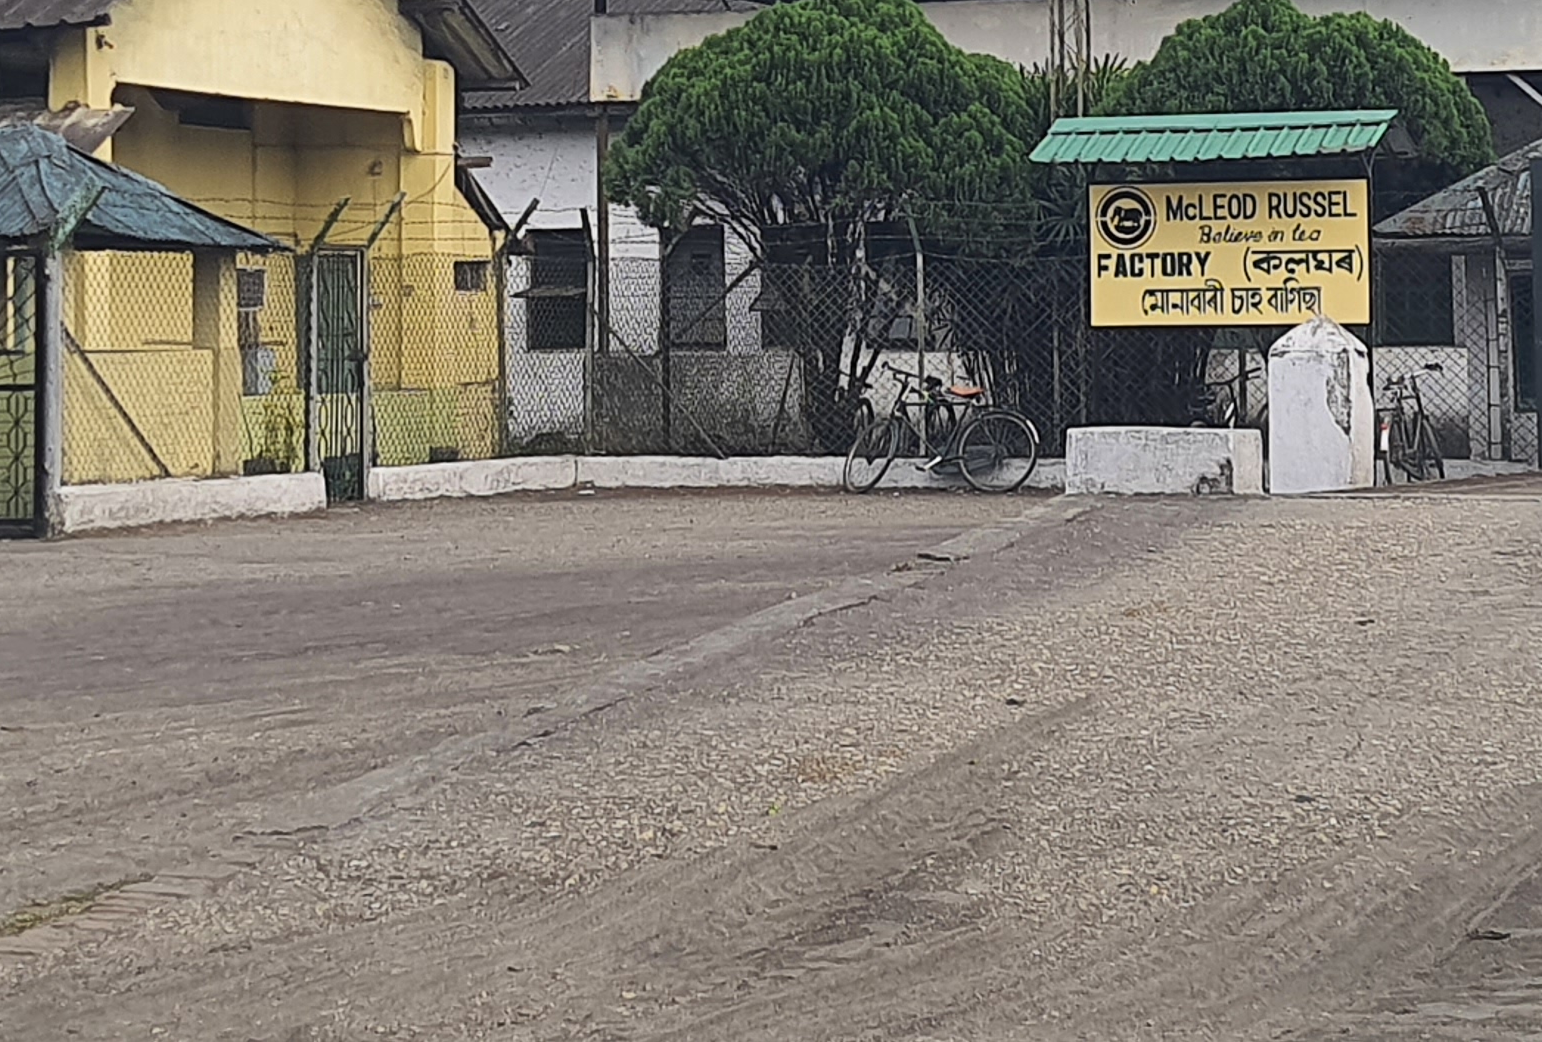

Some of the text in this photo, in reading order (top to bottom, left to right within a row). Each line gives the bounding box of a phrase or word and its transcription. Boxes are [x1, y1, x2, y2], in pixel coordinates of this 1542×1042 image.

[1165, 190, 1357, 221] McLEOD RUSSEL
[1267, 227, 1285, 243] in
[1292, 223, 1322, 242] tea
[1097, 251, 1212, 278] FACTORY
[1230, 287, 1263, 315] চাহ
